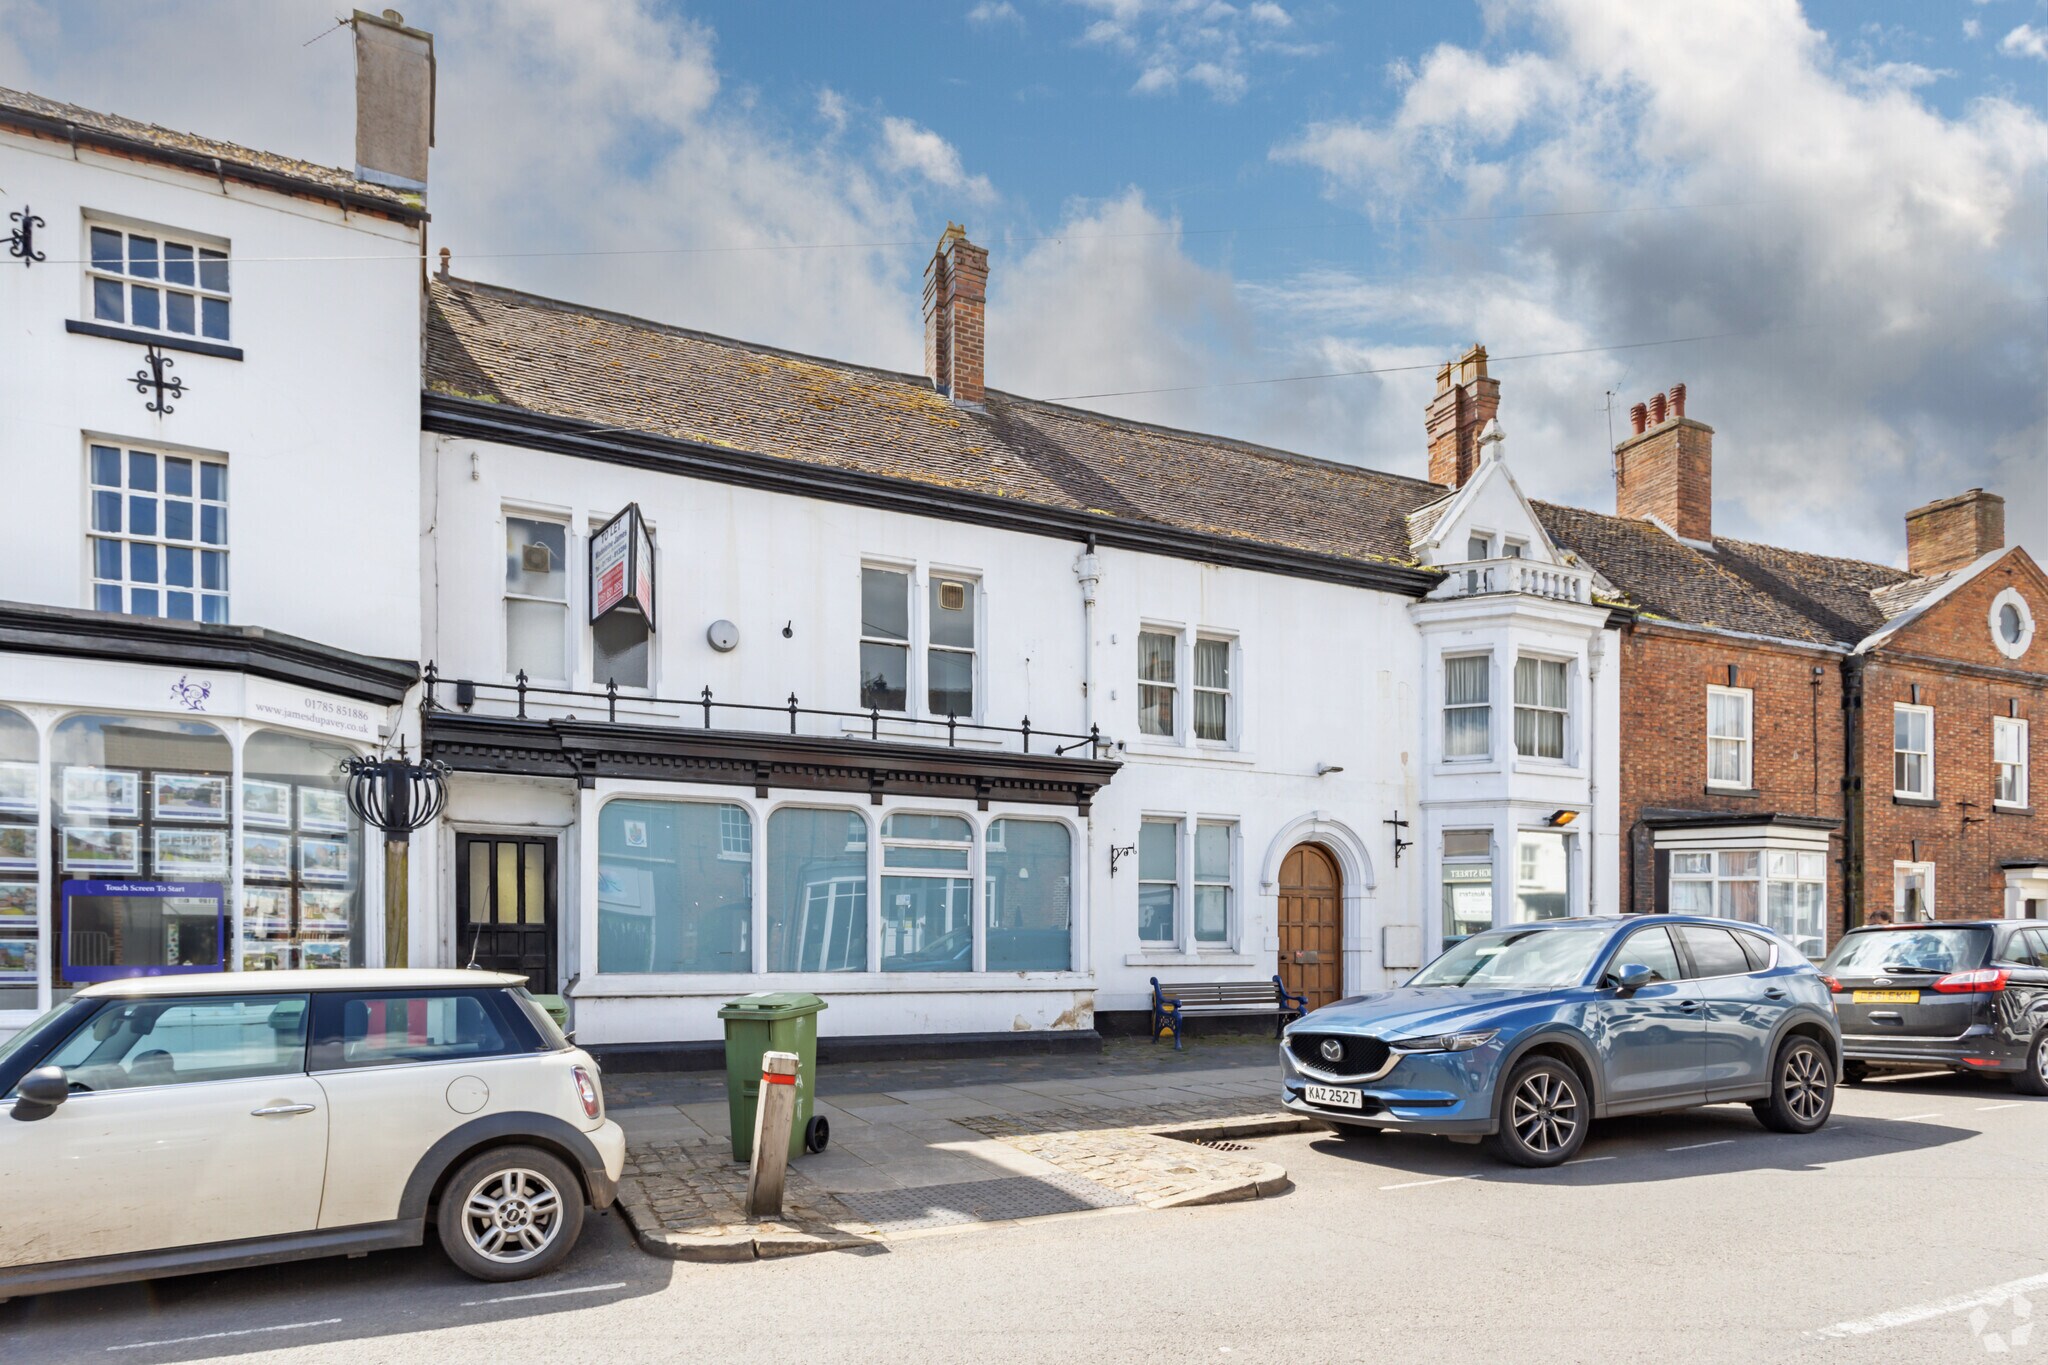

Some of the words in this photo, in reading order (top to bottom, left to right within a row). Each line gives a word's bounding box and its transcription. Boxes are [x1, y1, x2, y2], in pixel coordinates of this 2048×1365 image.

[601, 530, 608, 543] TO
[610, 519, 621, 536] LET
[255, 703, 369, 734] www.jamesdupavey.co.uk
[304, 698, 334, 713] 01785
[336, 705, 369, 721] 851886
[167, 885, 185, 893] Start
[1309, 1087, 1327, 1101] KAZ
[1328, 1089, 1357, 1105] 2527
